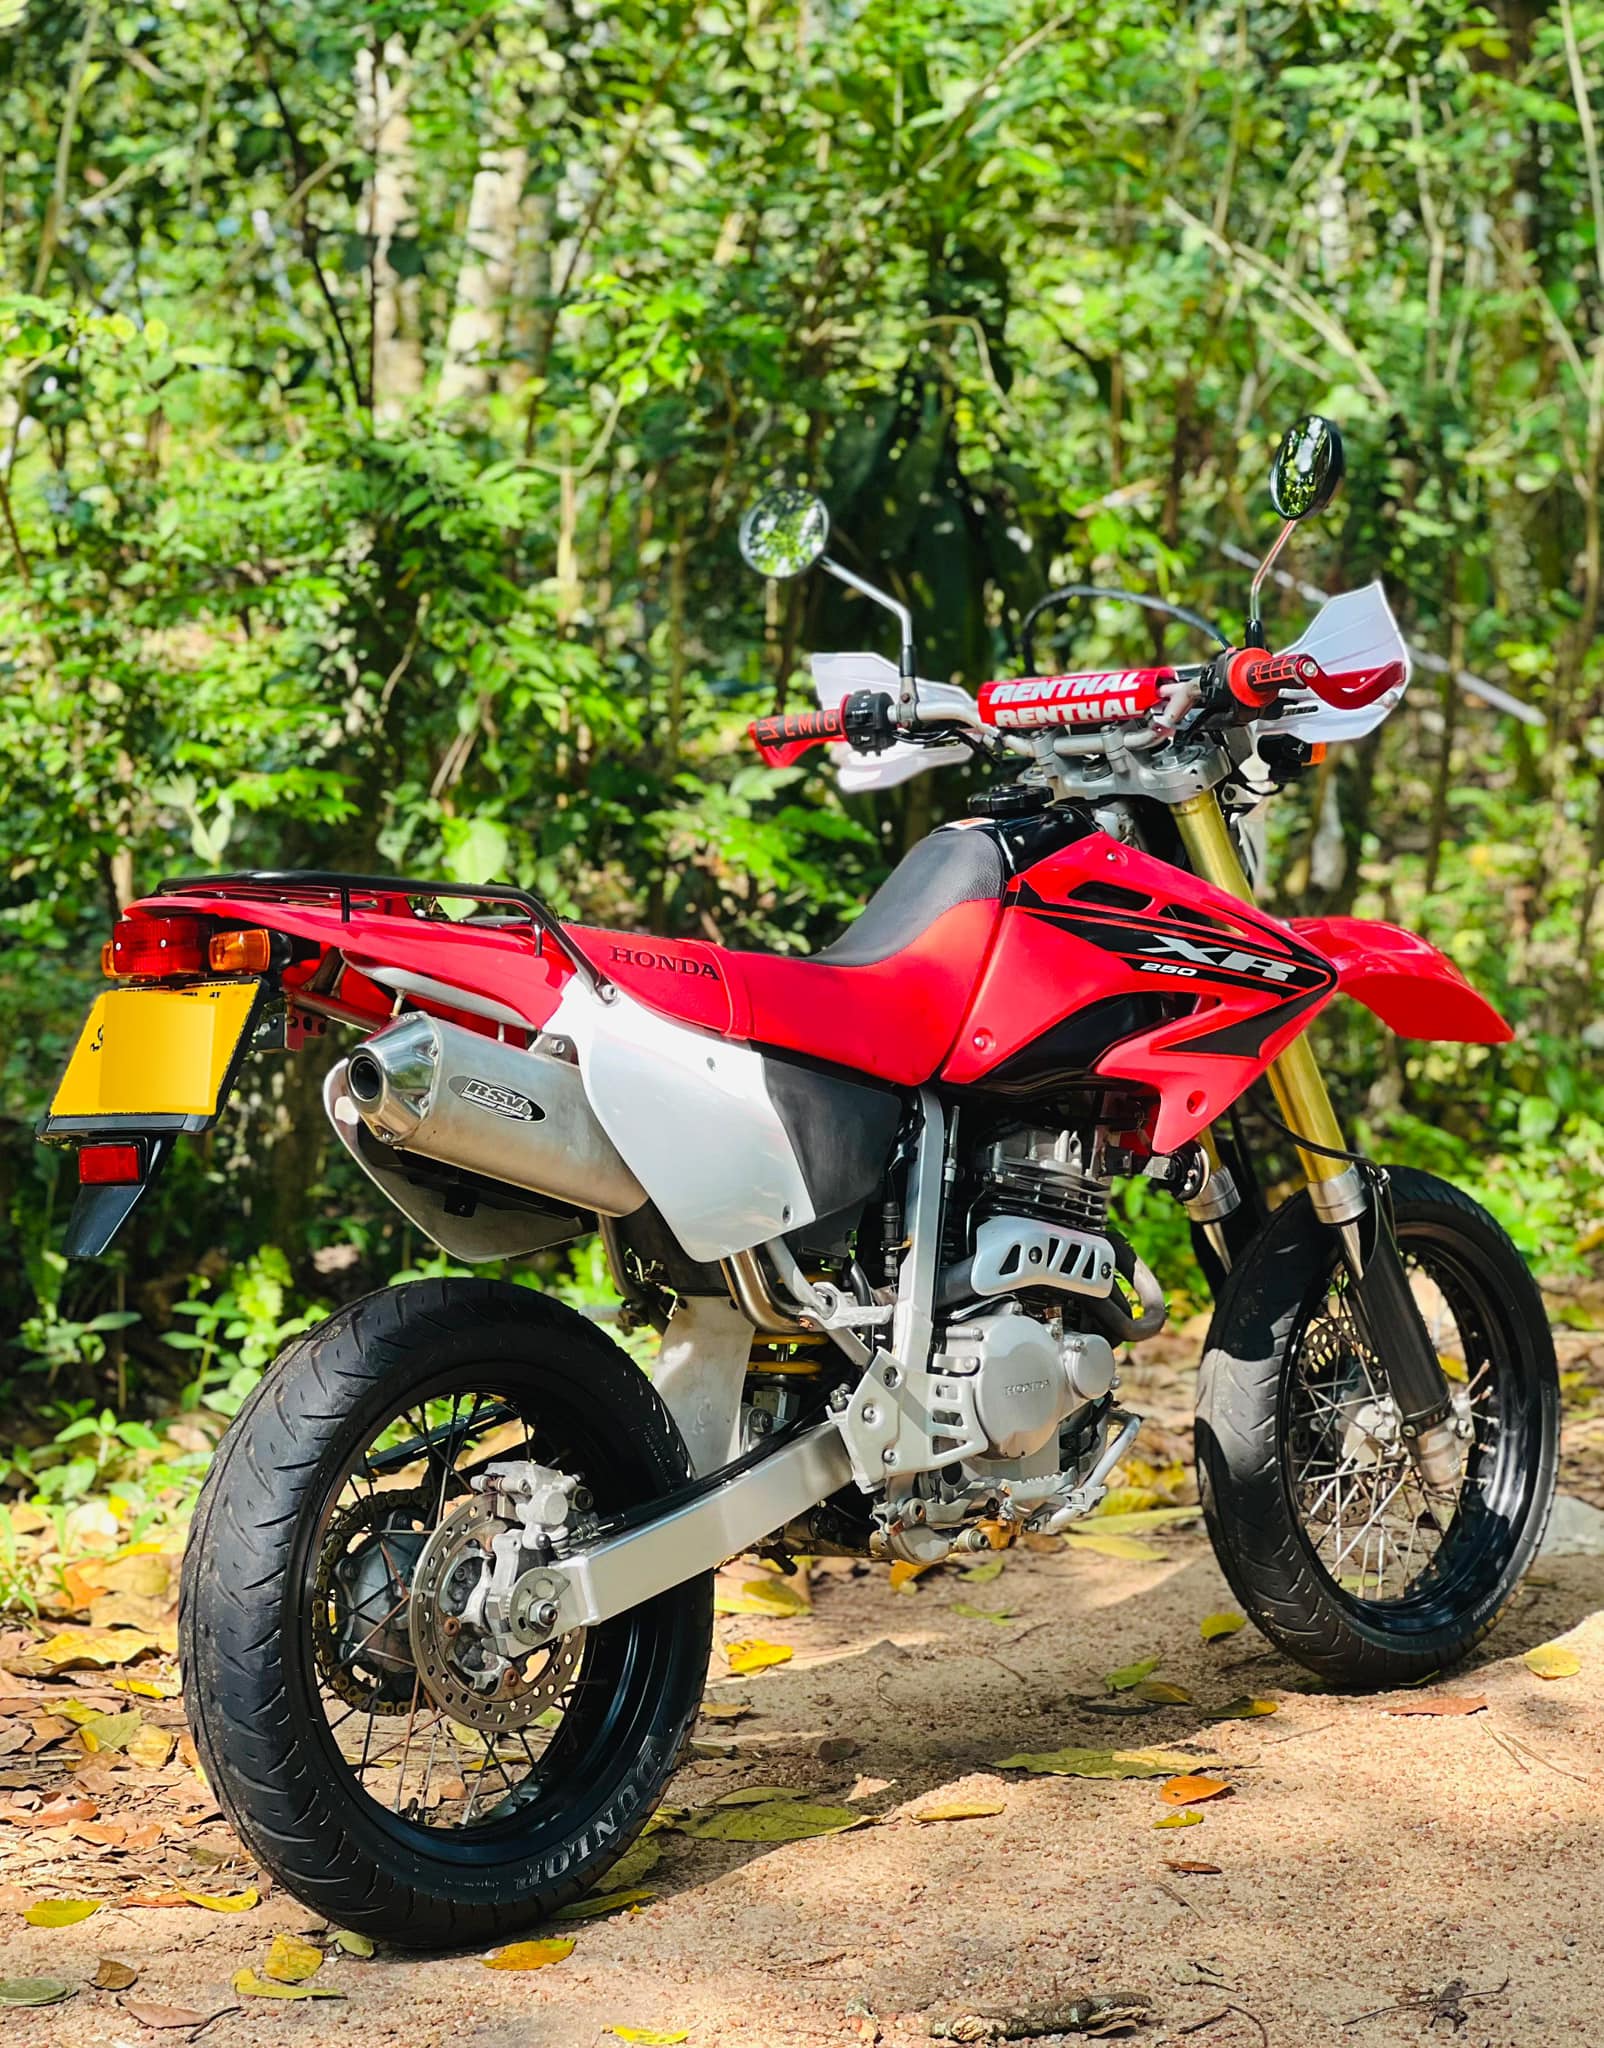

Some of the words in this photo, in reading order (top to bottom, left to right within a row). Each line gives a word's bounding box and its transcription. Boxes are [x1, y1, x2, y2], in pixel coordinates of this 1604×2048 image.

[989, 672, 1140, 704] RENTHAL
[784, 708, 837, 737] EMIG
[995, 697, 1144, 727] RENTHAL
[609, 945, 720, 981] HONDA
[1136, 934, 1297, 982] XR
[1140, 962, 1198, 976] 250
[464, 1079, 529, 1112] RSV
